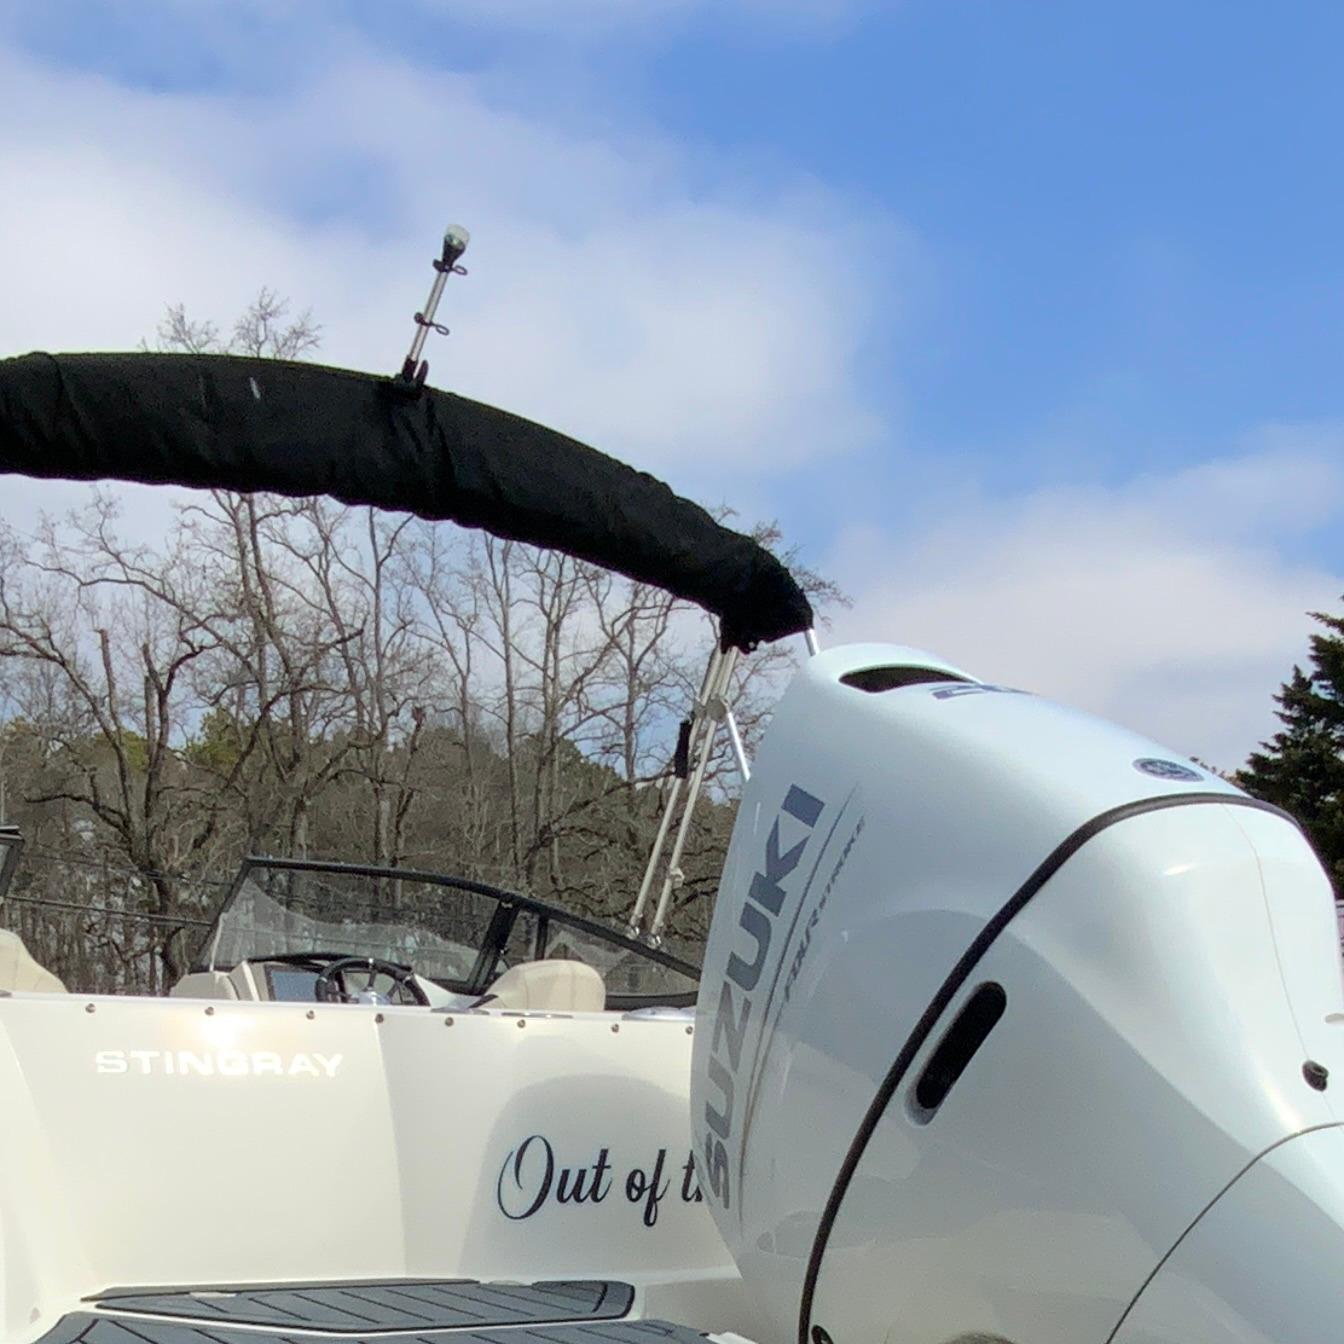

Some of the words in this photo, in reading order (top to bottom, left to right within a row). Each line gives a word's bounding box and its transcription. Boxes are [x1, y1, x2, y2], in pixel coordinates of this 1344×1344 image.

[705, 783, 826, 1210] SUZUKI
[94, 1049, 345, 1078] STINGRAY
[497, 1134, 613, 1221] Out
[625, 1148, 671, 1228] of
